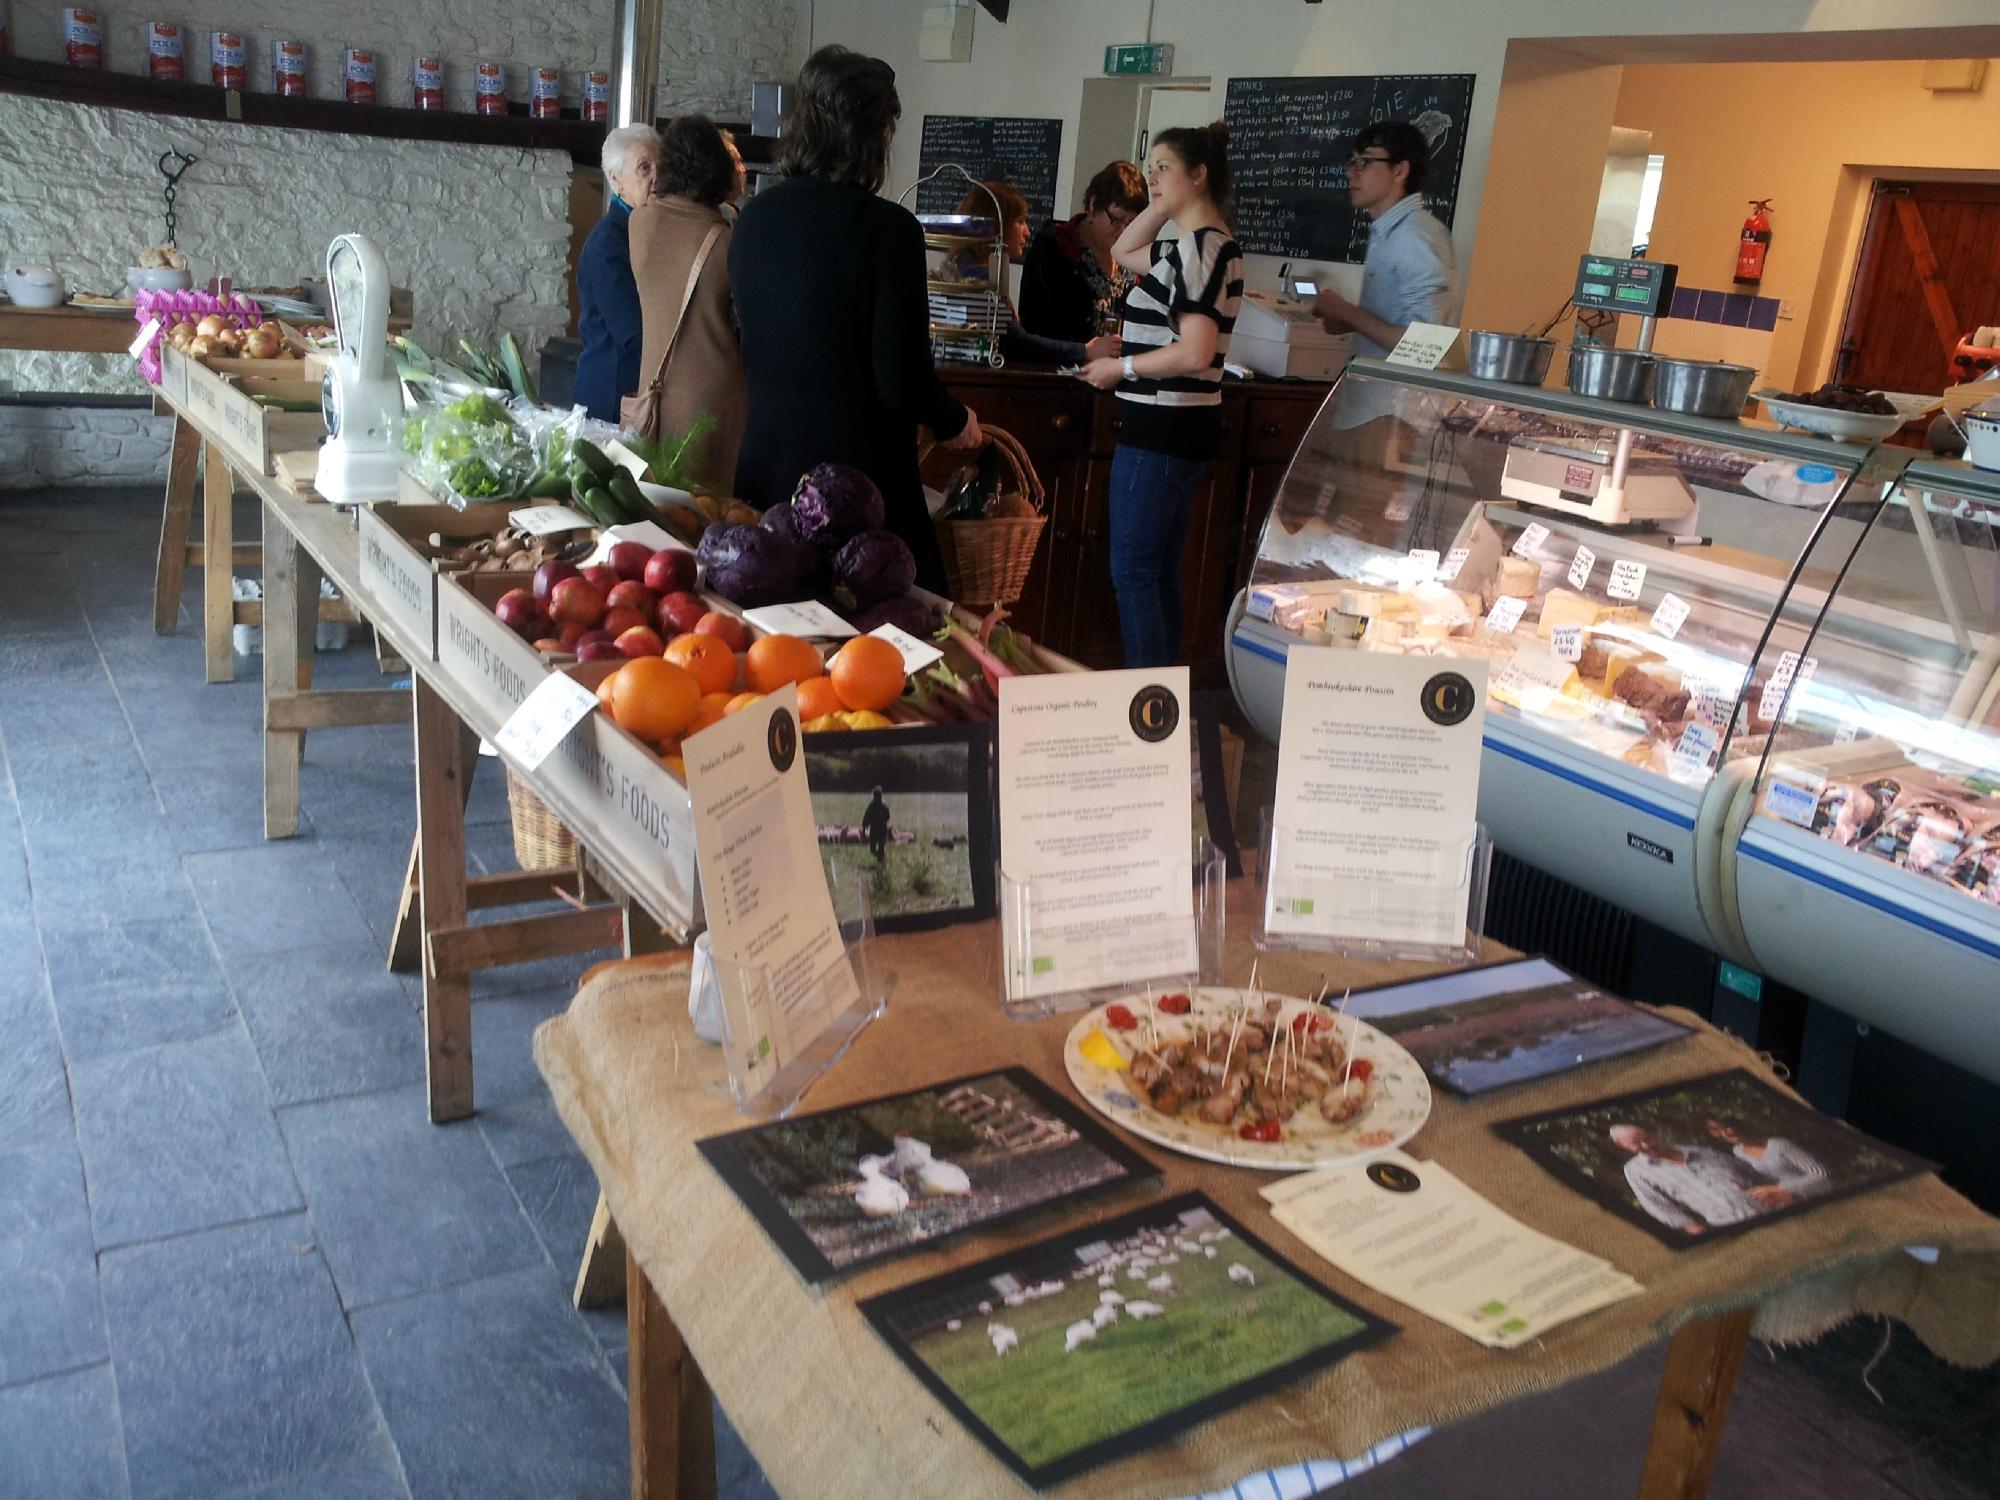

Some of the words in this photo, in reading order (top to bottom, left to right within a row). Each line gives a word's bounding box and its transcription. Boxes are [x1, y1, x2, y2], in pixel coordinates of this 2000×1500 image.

[449, 612, 491, 676] WRIGHT'S
[1142, 699, 1164, 728] C
[1435, 684, 1459, 713] C
[621, 773, 670, 849] FOODS
